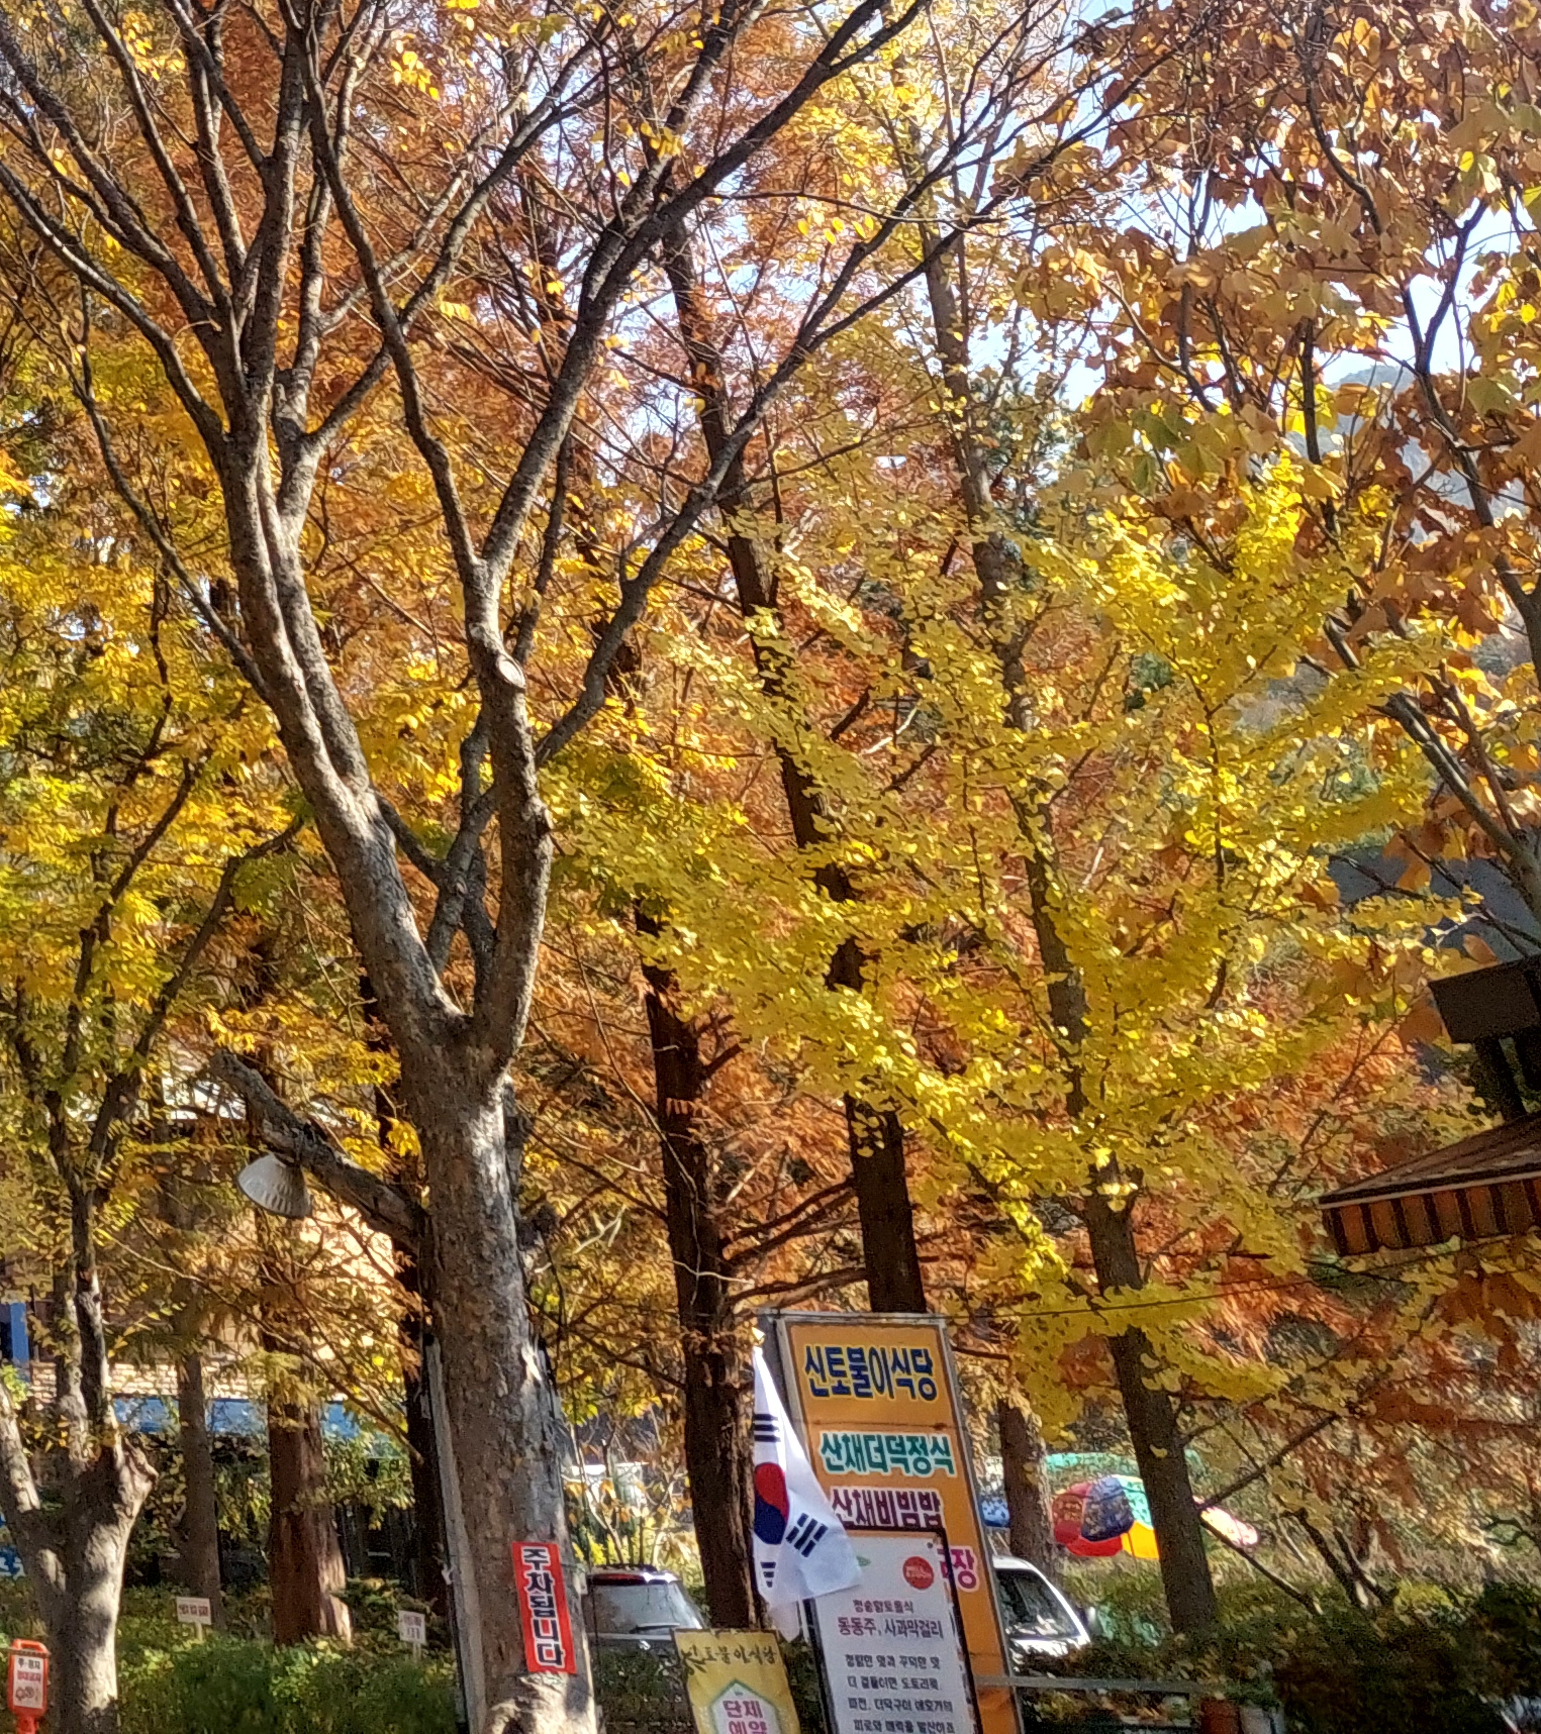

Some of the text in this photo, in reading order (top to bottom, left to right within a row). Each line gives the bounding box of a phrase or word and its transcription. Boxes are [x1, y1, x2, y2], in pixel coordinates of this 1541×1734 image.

[804, 1344, 938, 1402] 신토불이식당
[820, 1431, 955, 1476] 산채더덕정식
[831, 1488, 945, 1529] 산채비빔밥
[522, 1547, 564, 1667] 주차됩니다
[884, 1618, 944, 1639] 사과막걸리
[722, 1700, 764, 1719] 단체
